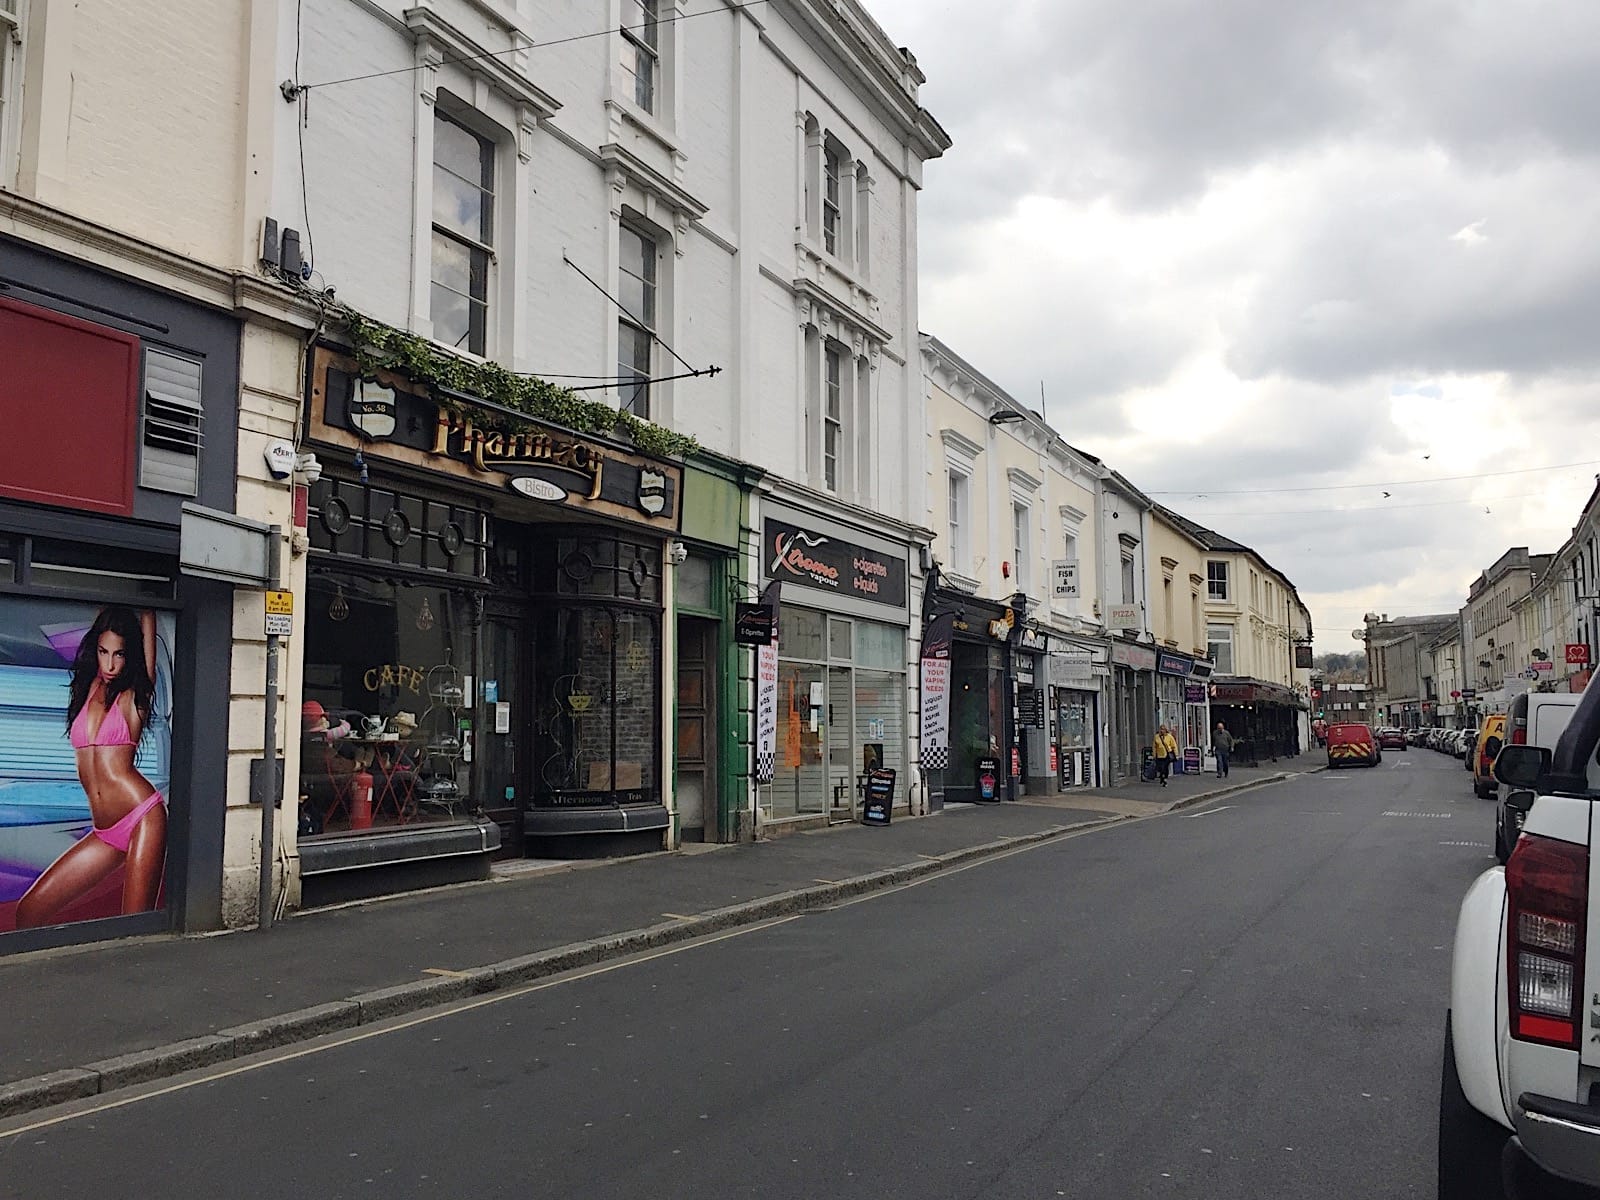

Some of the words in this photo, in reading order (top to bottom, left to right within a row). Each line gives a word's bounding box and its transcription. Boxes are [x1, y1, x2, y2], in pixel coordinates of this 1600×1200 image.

[376, 404, 386, 413] 58
[524, 479, 555, 499] Bistro
[853, 557, 888, 577] e-cigarettes
[1058, 570, 1073, 578] FISH
[810, 572, 839, 588] vapour
[1056, 585, 1076, 593] CHIPS
[1113, 610, 1136, 618] PIZZA
[923, 660, 937, 668] FOR
[363, 664, 424, 696] CAFÉ
